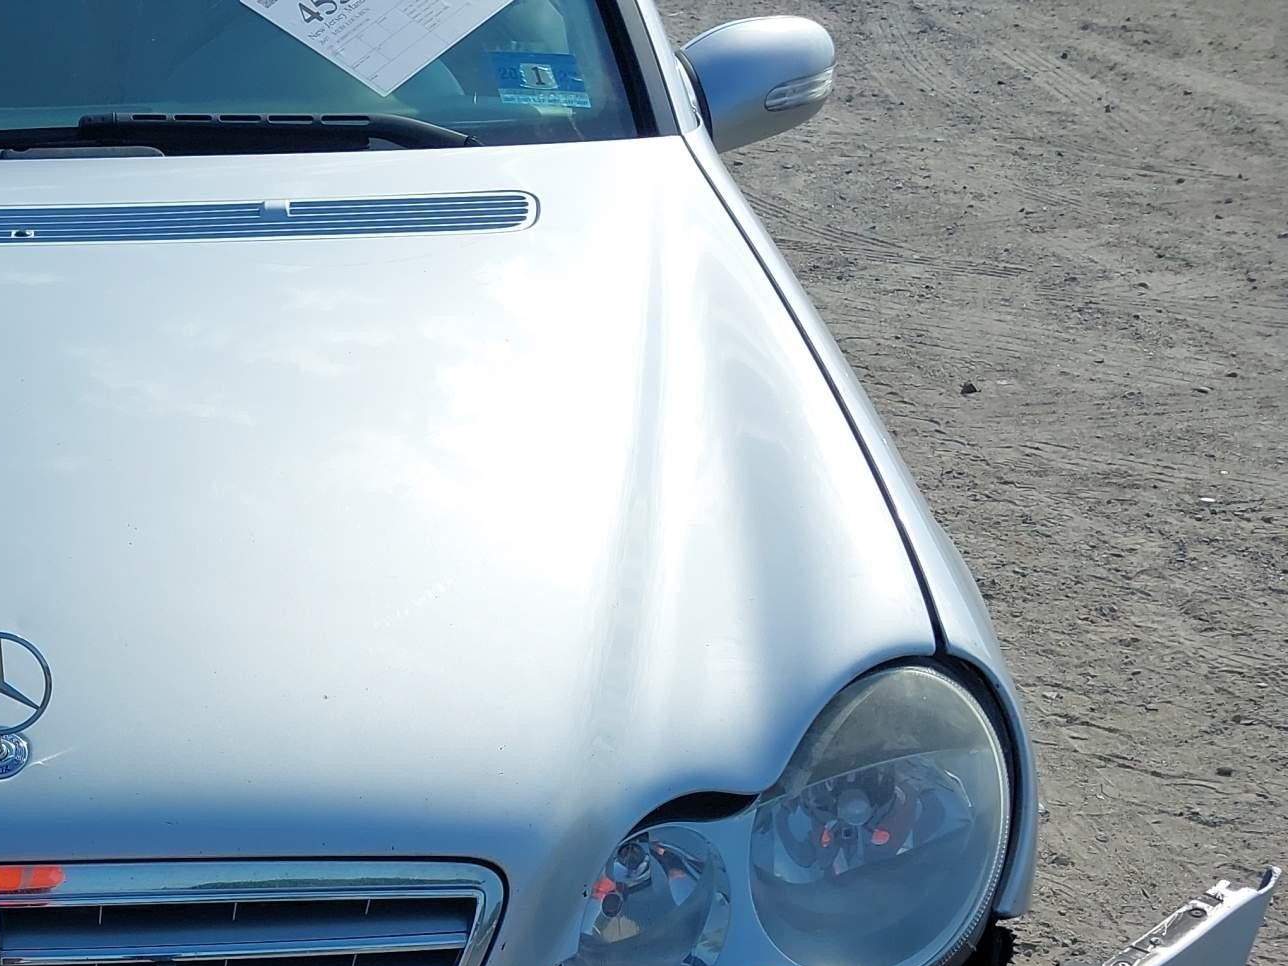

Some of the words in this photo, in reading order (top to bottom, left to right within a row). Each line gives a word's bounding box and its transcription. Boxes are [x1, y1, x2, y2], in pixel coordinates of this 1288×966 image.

[298, 0, 351, 24] 45
[308, 27, 326, 41] New
[323, 11, 349, 29] Jersey
[531, 66, 547, 86] 1
